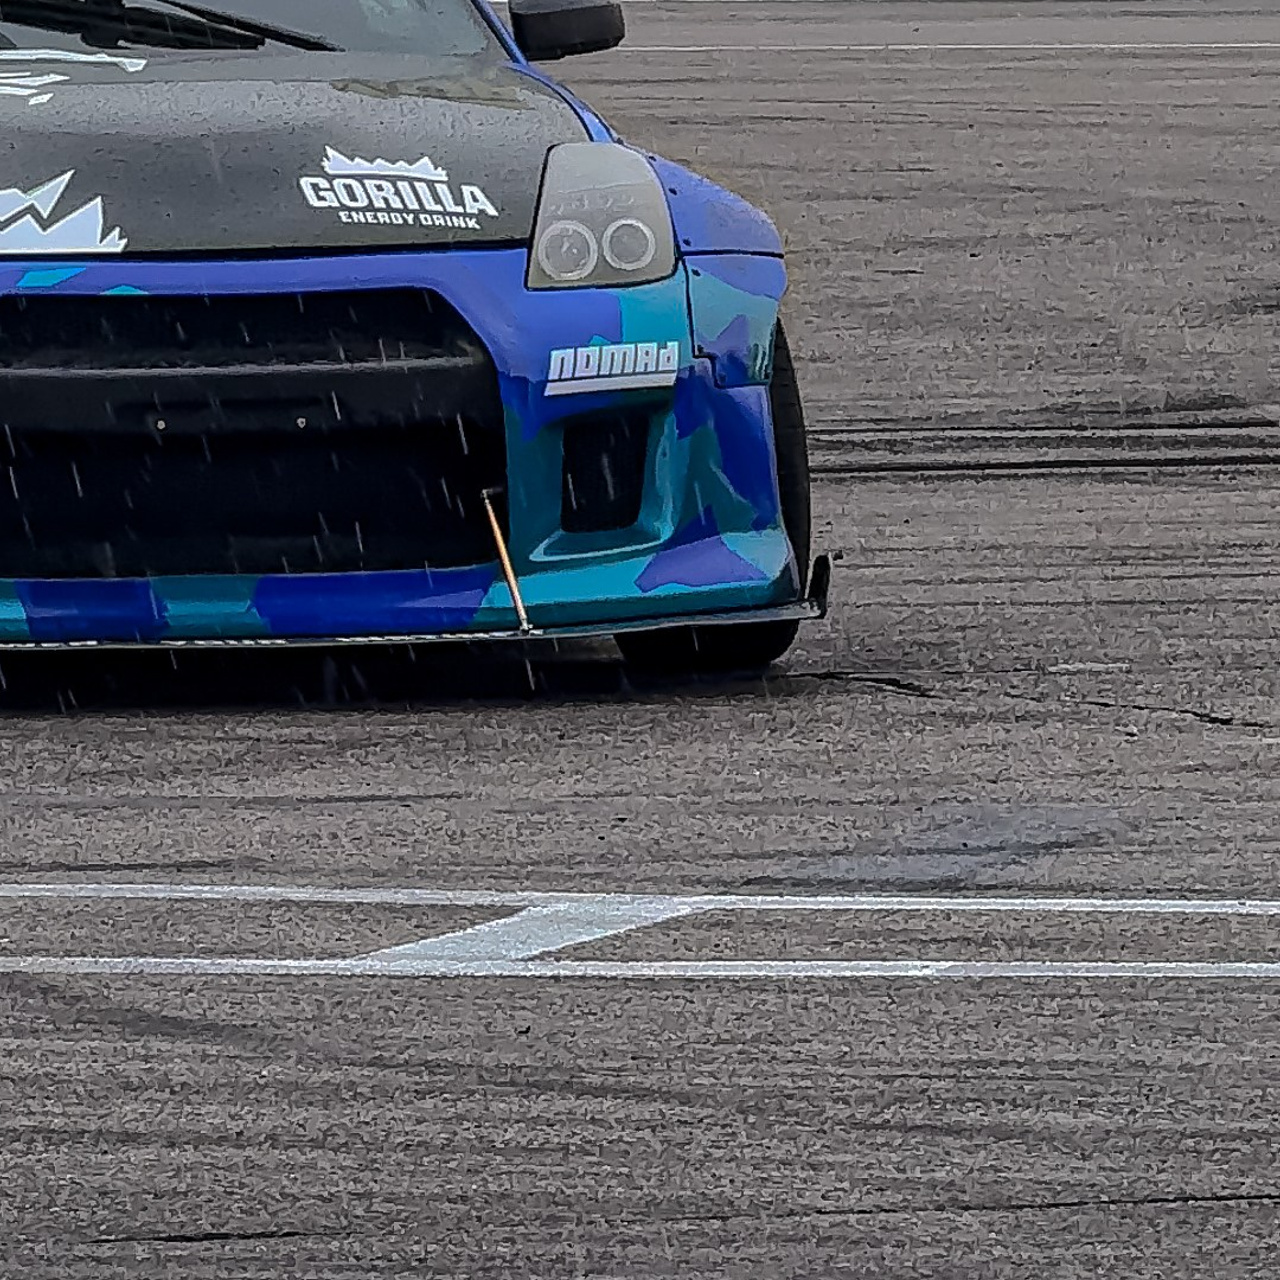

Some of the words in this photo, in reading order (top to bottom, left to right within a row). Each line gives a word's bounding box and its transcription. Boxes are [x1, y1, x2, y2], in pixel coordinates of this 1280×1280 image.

[300, 176, 499, 217] GORILLA
[338, 210, 415, 226] ENERGY
[419, 213, 481, 230] DRINK
